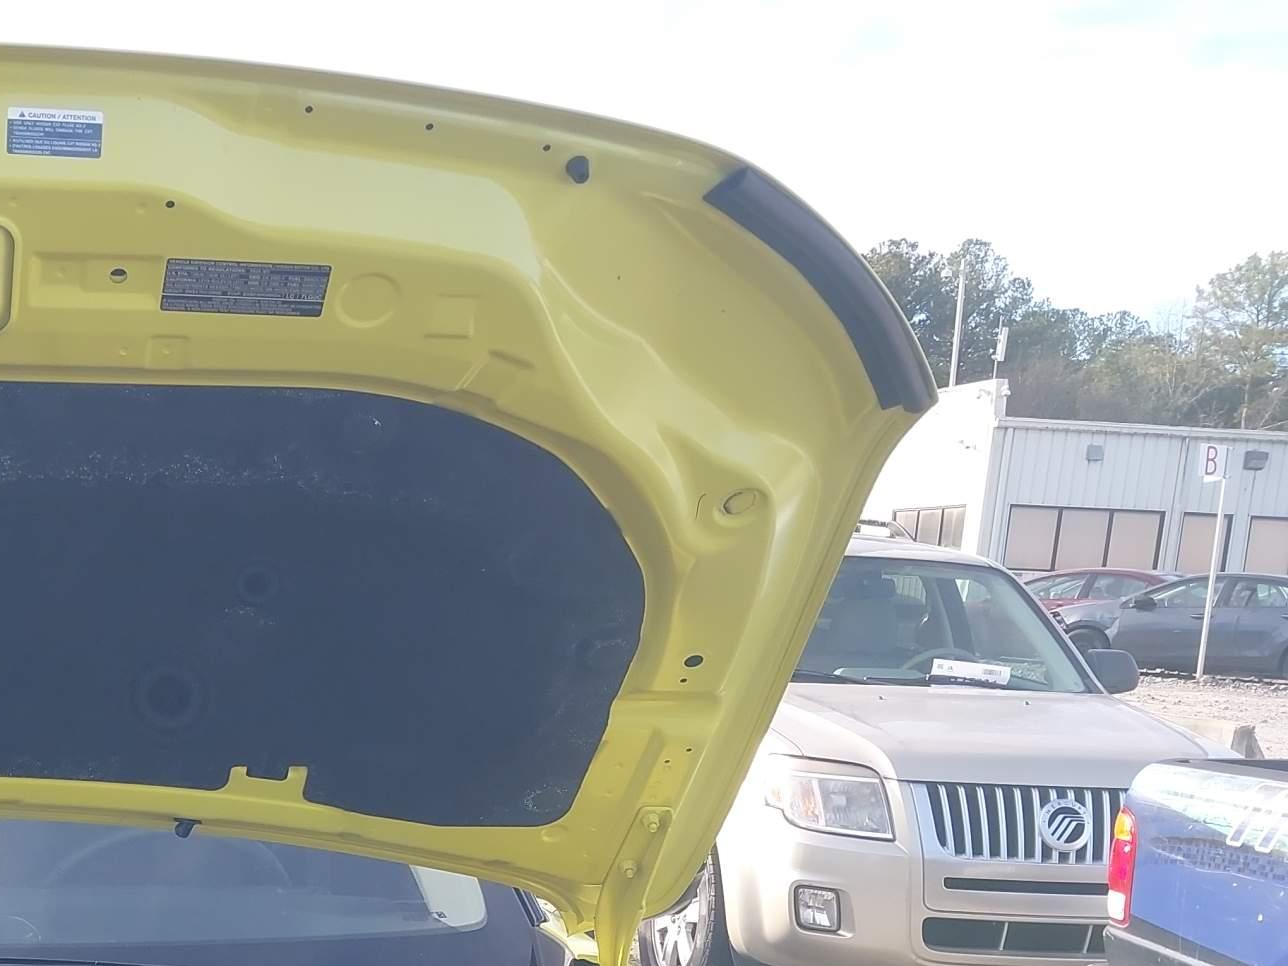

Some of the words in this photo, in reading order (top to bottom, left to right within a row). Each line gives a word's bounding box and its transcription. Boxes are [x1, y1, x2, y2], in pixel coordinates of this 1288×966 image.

[28, 112, 56, 120] CAUTION
[62, 113, 97, 121] ATTENTION
[1205, 445, 1218, 476] B
